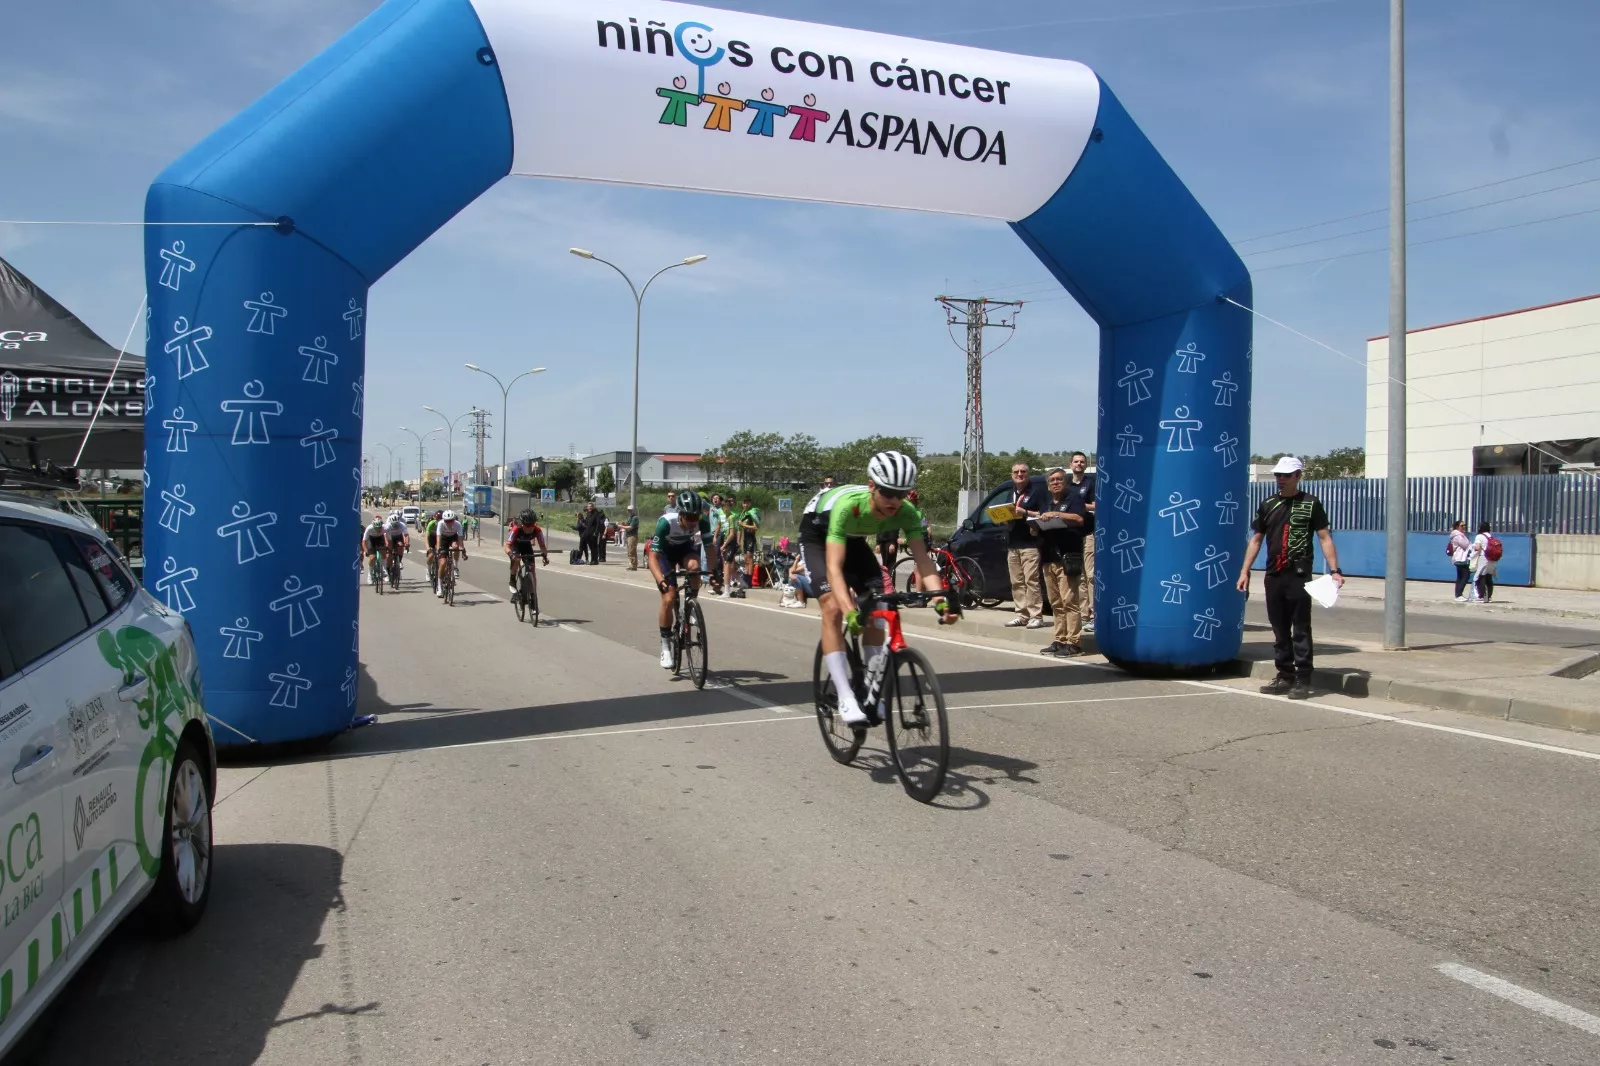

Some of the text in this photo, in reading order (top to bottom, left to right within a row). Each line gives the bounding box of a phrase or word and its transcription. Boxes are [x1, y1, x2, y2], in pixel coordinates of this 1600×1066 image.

[770, 46, 854, 82] con
[869, 58, 1011, 105] cáncer
[827, 108, 1007, 166] ASPANOA
[88, 782, 113, 814] RENAULT
